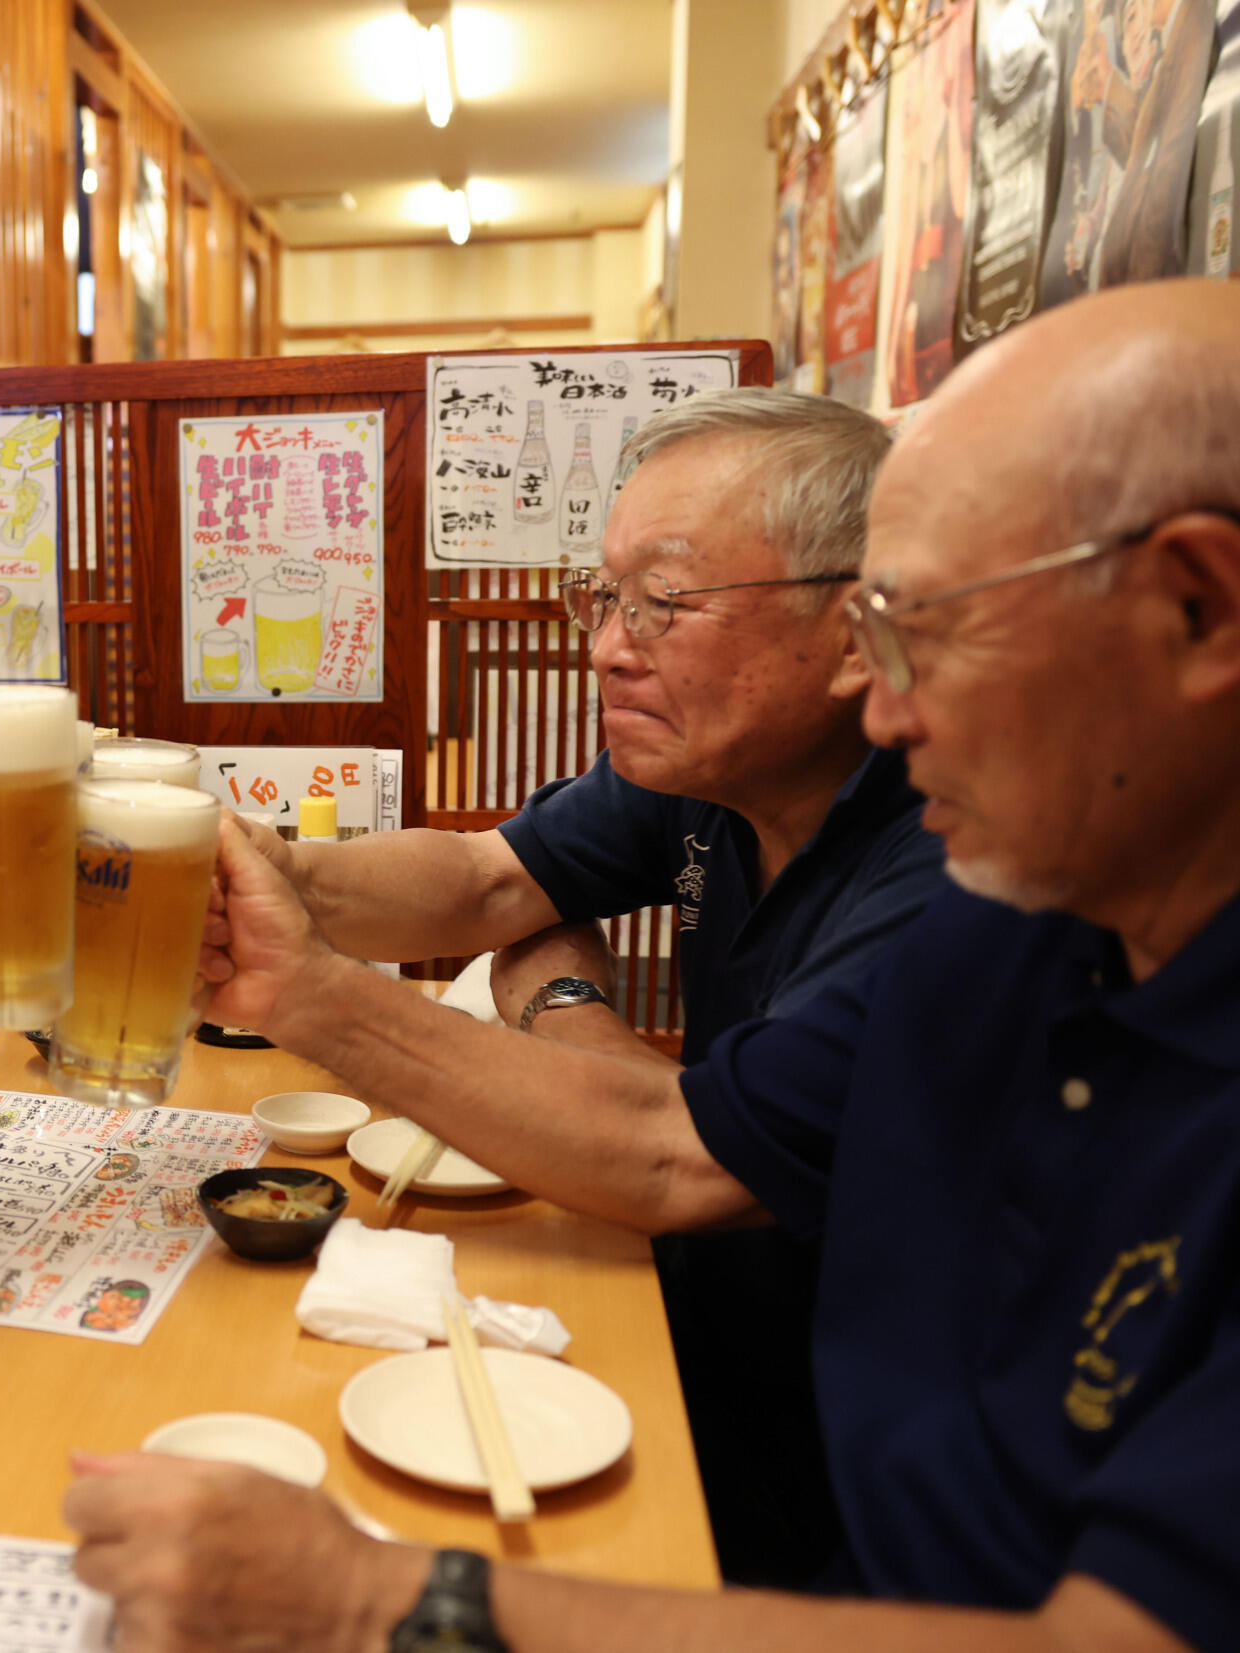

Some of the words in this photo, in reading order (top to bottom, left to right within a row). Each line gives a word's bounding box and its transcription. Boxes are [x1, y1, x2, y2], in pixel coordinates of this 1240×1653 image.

[561, 384, 628, 399] 日本酒
[436, 459, 510, 478] 八海山
[223, 456, 251, 541] ハイボール
[520, 472, 543, 507] 辛口
[76, 848, 131, 891] sahi
